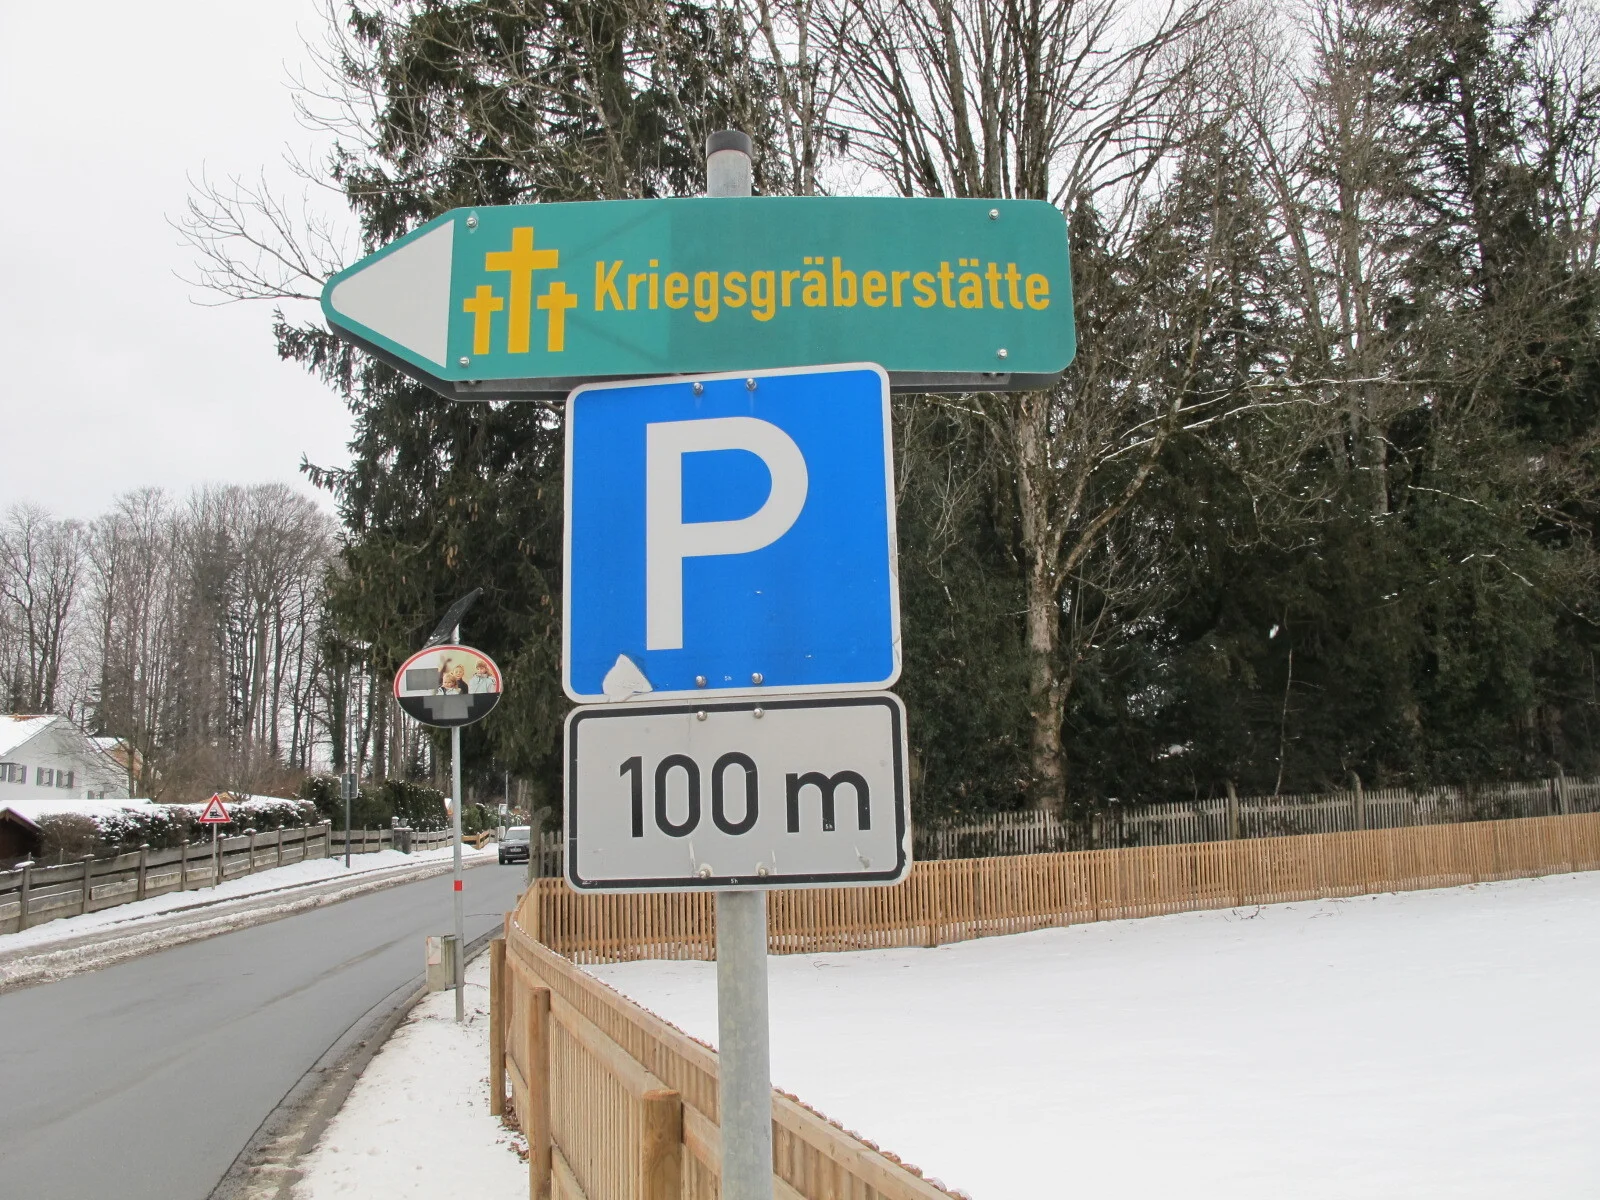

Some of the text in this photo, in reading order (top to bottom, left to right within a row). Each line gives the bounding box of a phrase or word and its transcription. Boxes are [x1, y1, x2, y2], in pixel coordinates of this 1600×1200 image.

[595, 257, 1050, 323] Kriegsgräberstätte
[646, 416, 809, 651] P
[619, 752, 871, 838] 100 m
